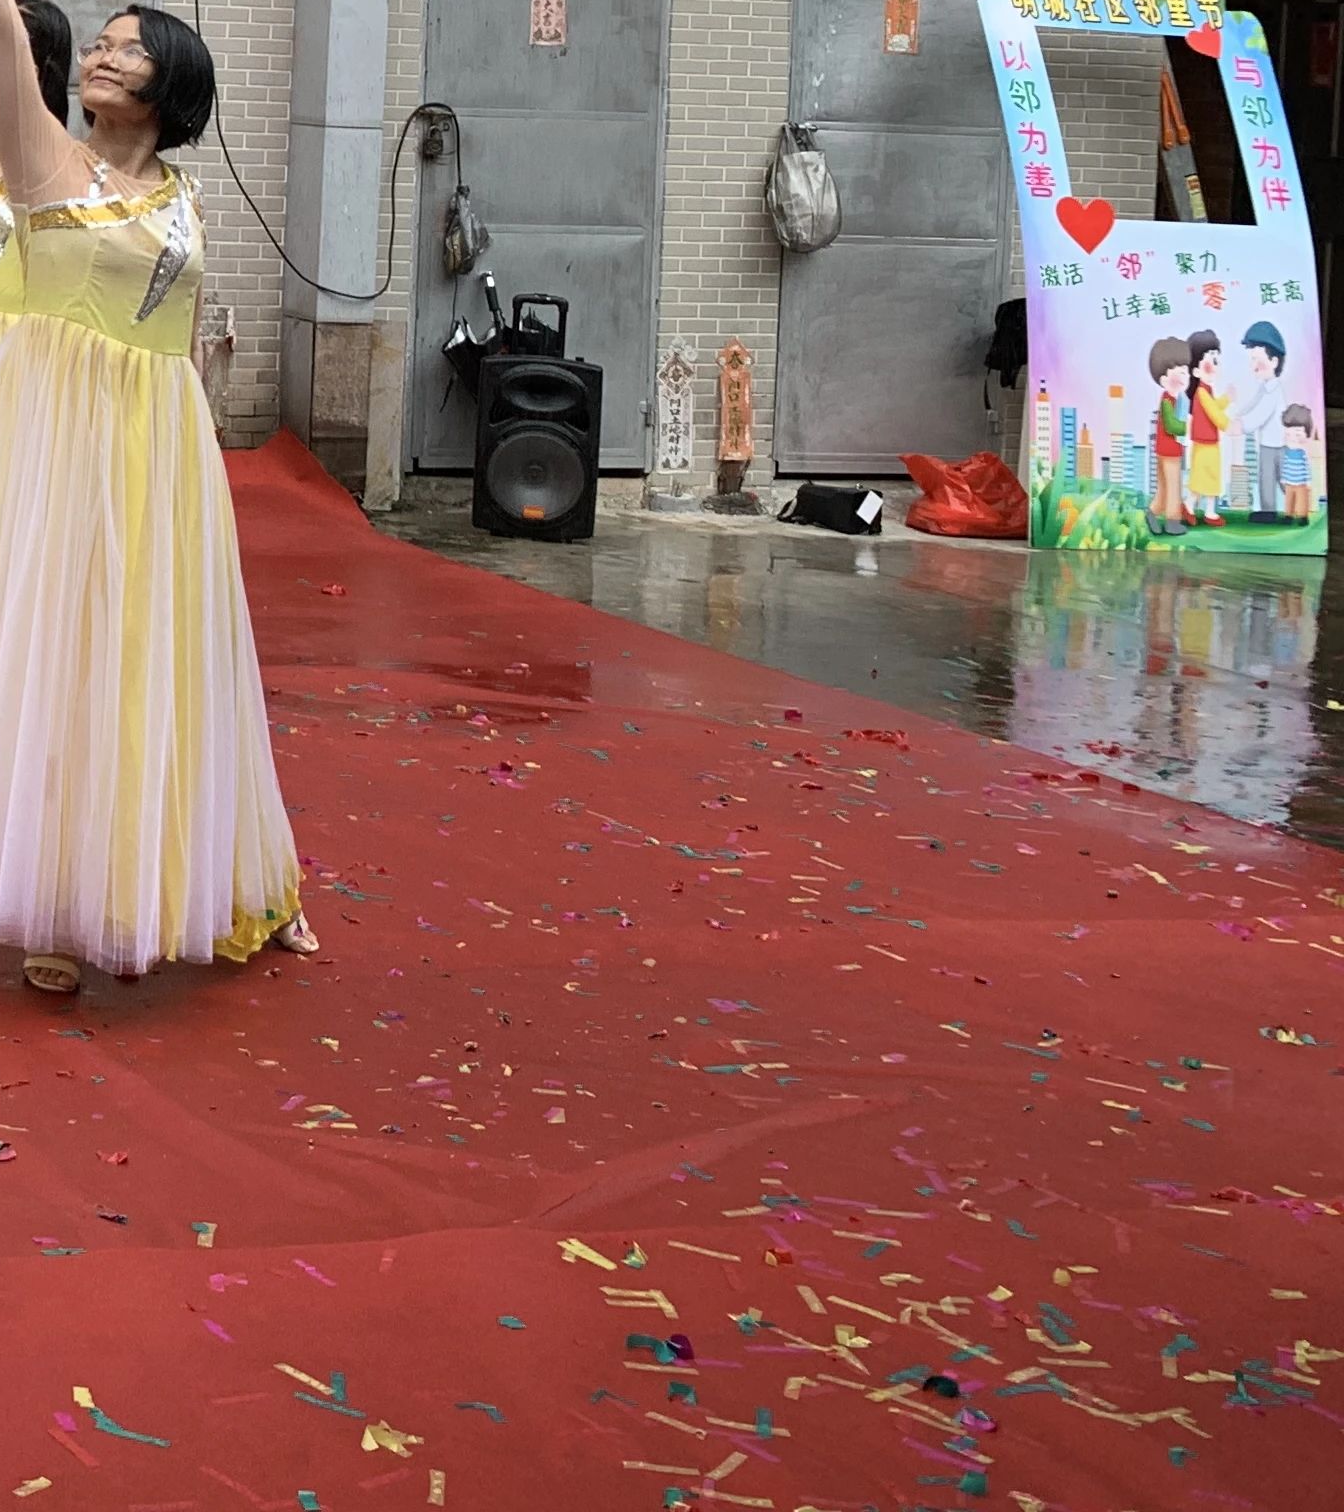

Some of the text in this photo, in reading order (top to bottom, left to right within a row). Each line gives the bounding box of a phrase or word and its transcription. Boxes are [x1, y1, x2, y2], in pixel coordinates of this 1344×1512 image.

[999, 40, 1056, 198] 以邻为善
[1234, 56, 1292, 211] 与邻为伴
